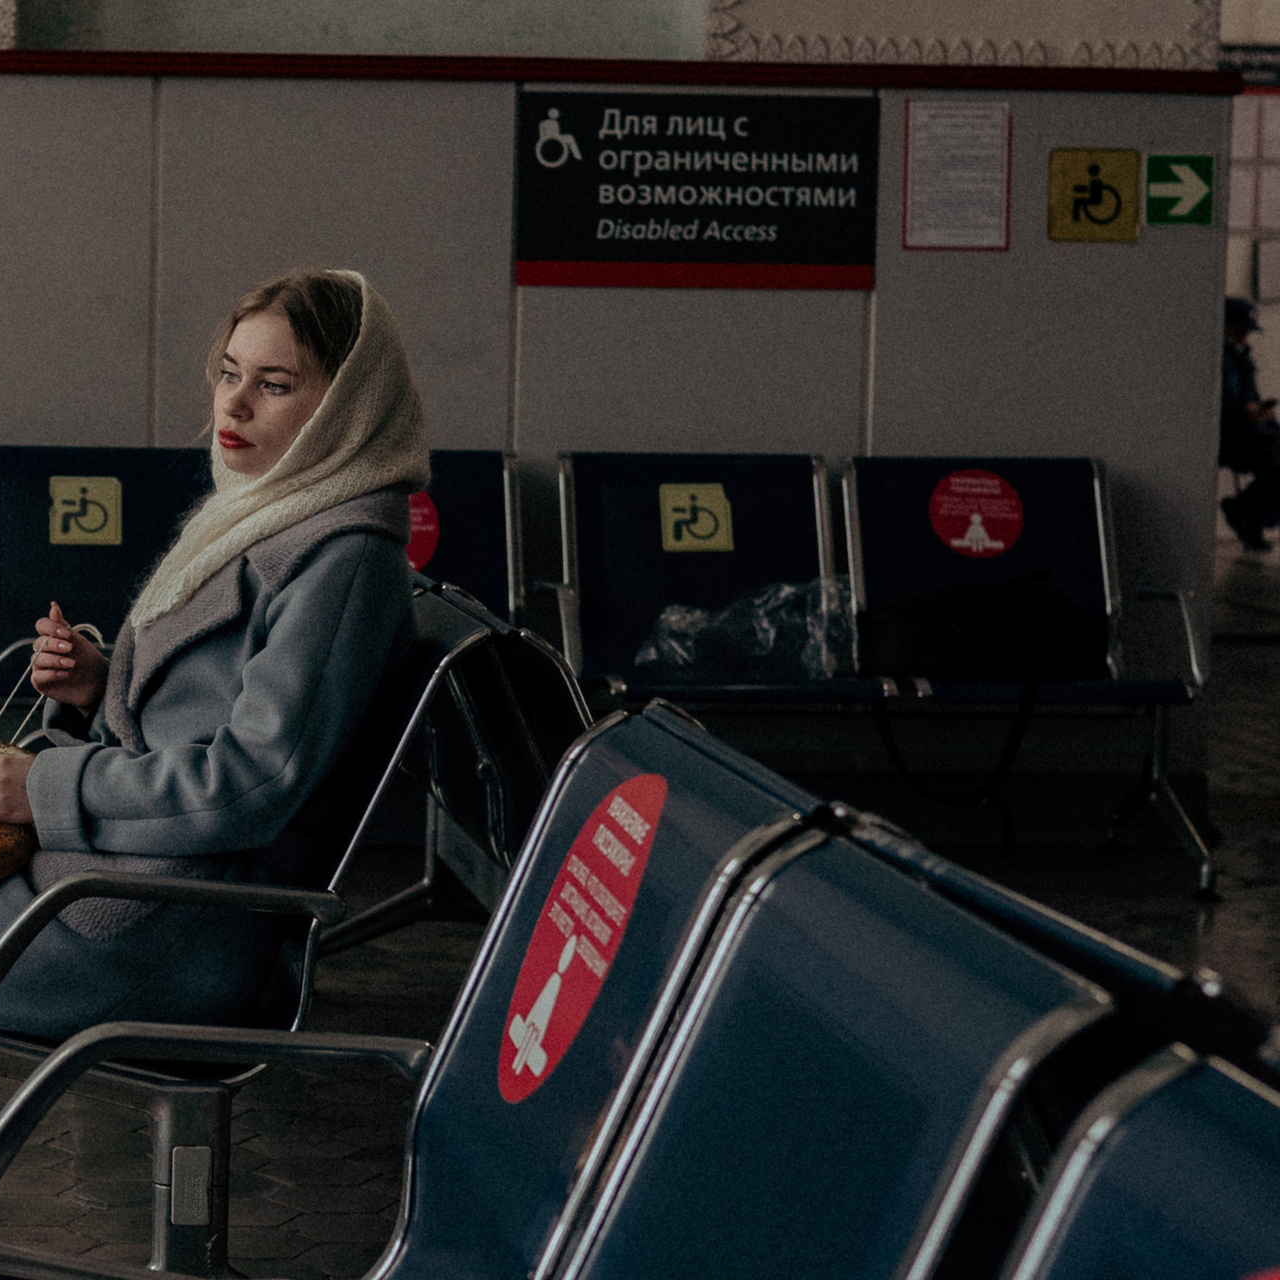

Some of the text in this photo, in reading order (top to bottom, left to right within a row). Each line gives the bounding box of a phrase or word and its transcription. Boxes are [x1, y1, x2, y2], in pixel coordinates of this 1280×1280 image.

[598, 107, 750, 141] Для лиц с
[598, 149, 860, 178] ограниченными
[598, 184, 858, 208] возможностями
[596, 218, 779, 242] Disabled Access
